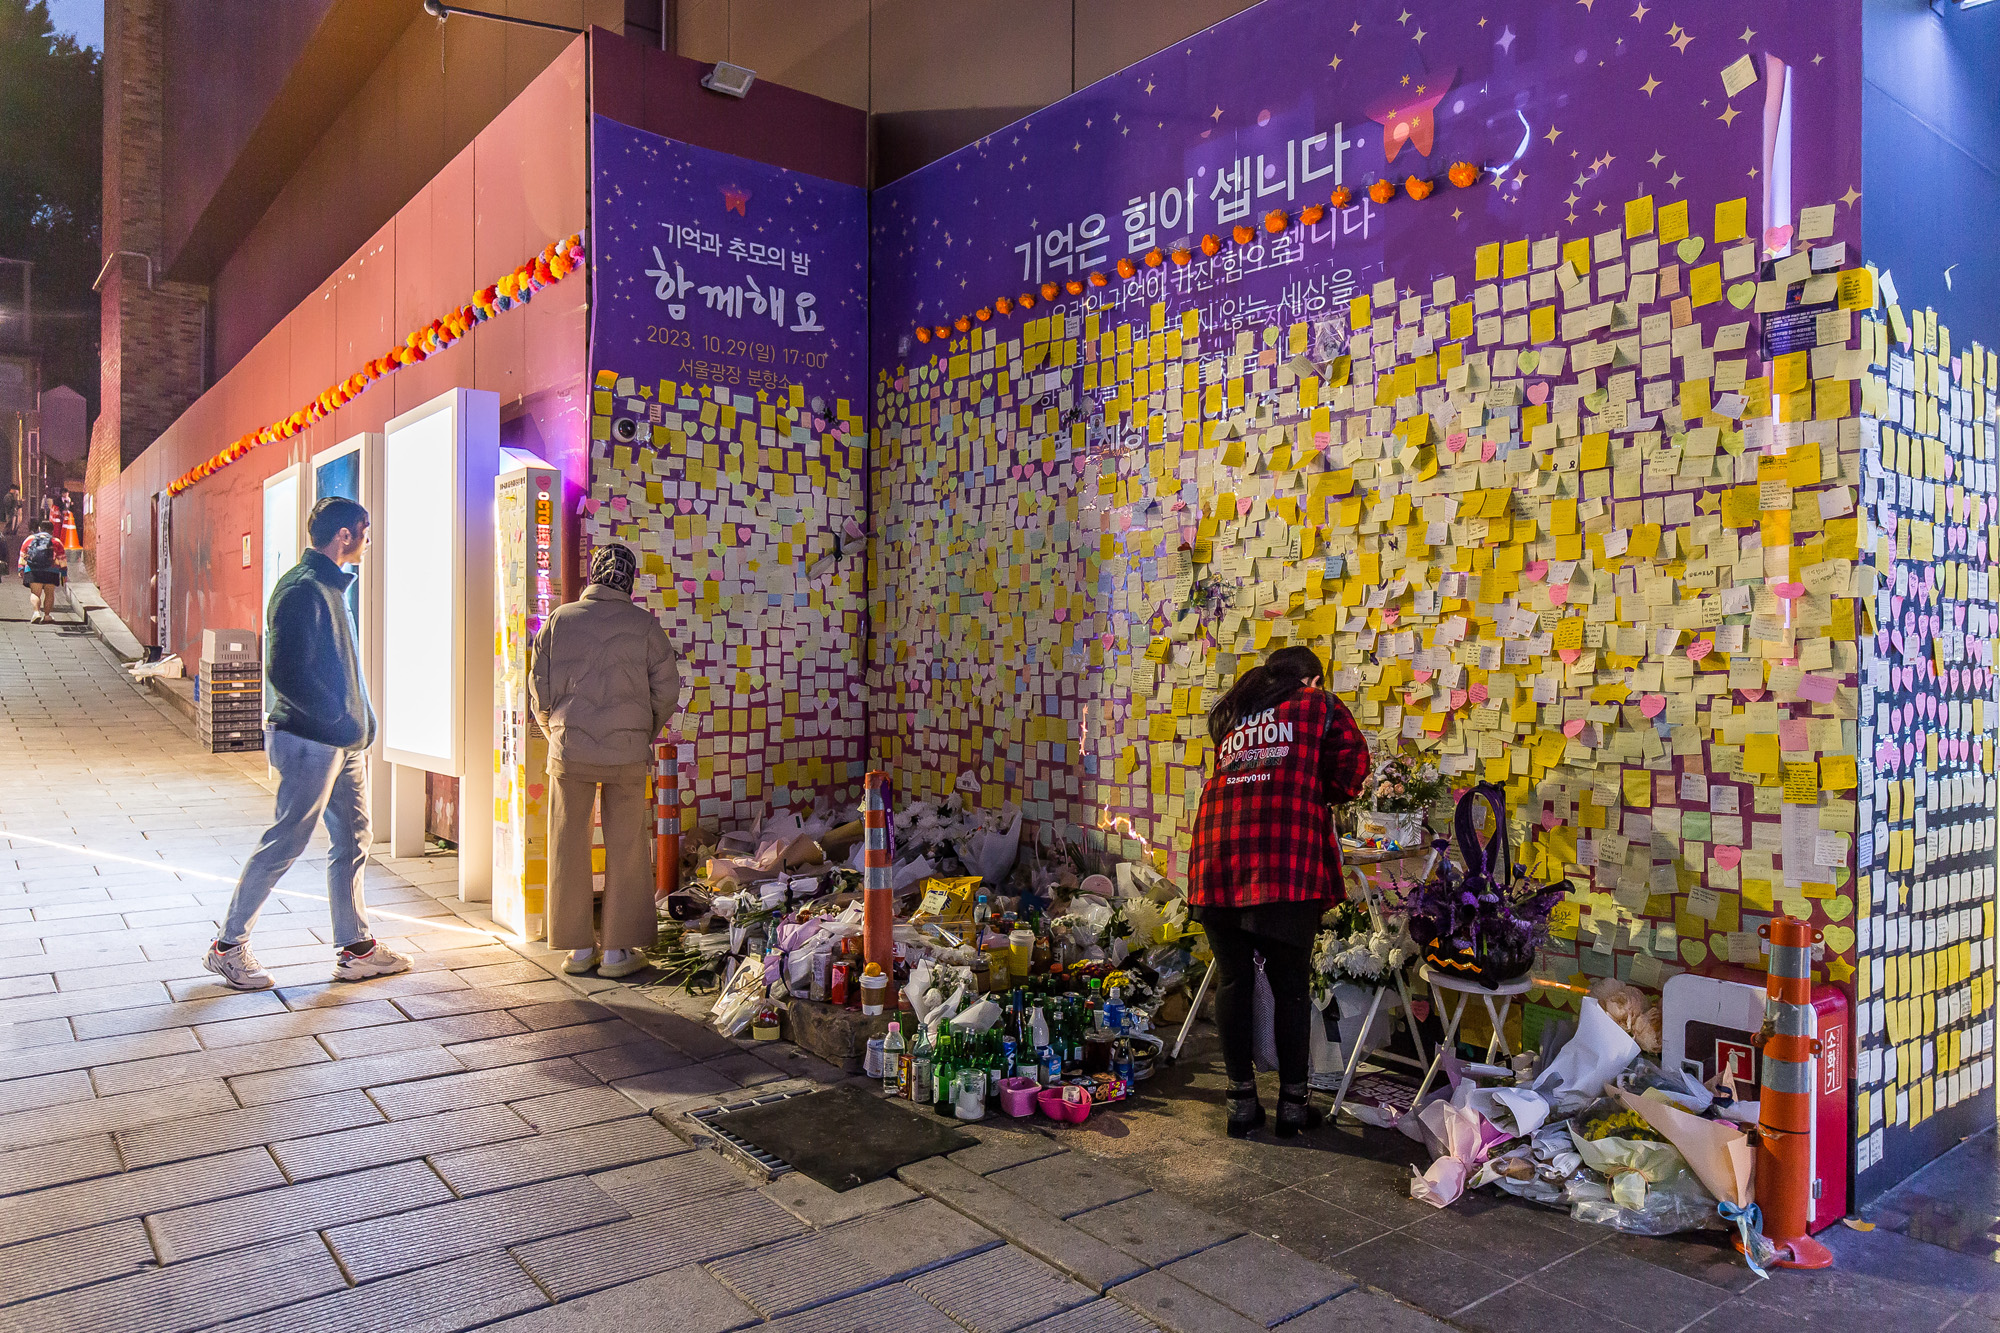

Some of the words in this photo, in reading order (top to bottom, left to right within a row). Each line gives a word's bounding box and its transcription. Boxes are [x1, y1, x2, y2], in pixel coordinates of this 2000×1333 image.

[1014, 212, 1110, 285] 기억은
[1122, 177, 1195, 254] 힘이
[1209, 121, 1351, 226] 셉니다
[661, 222, 723, 258] 기억과
[727, 237, 786, 271] 추모의
[791, 250, 812, 276] 밤
[1171, 256, 1214, 294] 가진
[1221, 235, 1295, 284] 힘으로
[644, 245, 825, 332] 함께해요
[1222, 294, 1270, 332] 않는
[1276, 268, 1356, 316] 세상을
[647, 325, 696, 350] 2023.
[701, 334, 776, 364] 10.29(일)
[783, 347, 826, 370] 17:00
[677, 357, 742, 385] 서울광장
[746, 367, 793, 391] 분향소
[1826, 1031, 1837, 1089] 소화기
